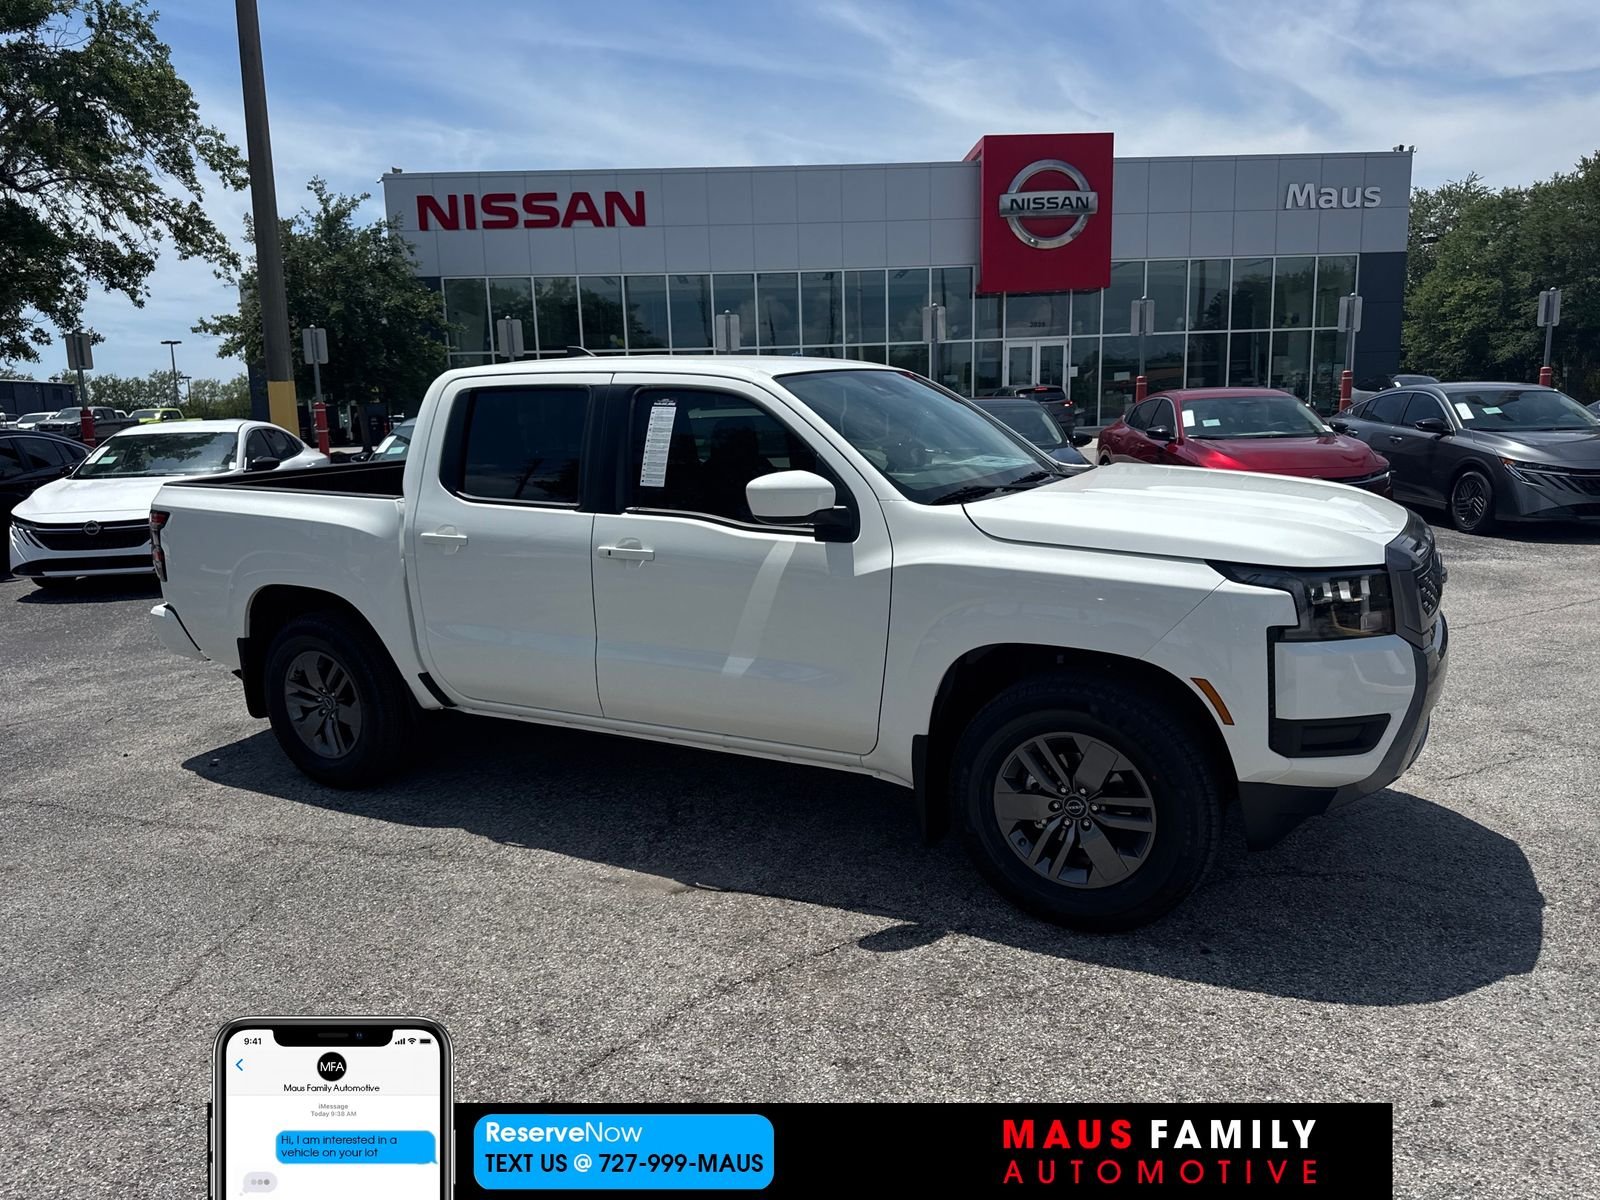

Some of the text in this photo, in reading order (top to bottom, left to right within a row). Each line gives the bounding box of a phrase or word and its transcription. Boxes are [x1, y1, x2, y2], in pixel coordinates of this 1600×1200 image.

[1010, 196, 1089, 211] NISSAN
[1285, 183, 1382, 209] Maus
[417, 191, 646, 231] NISSAN
